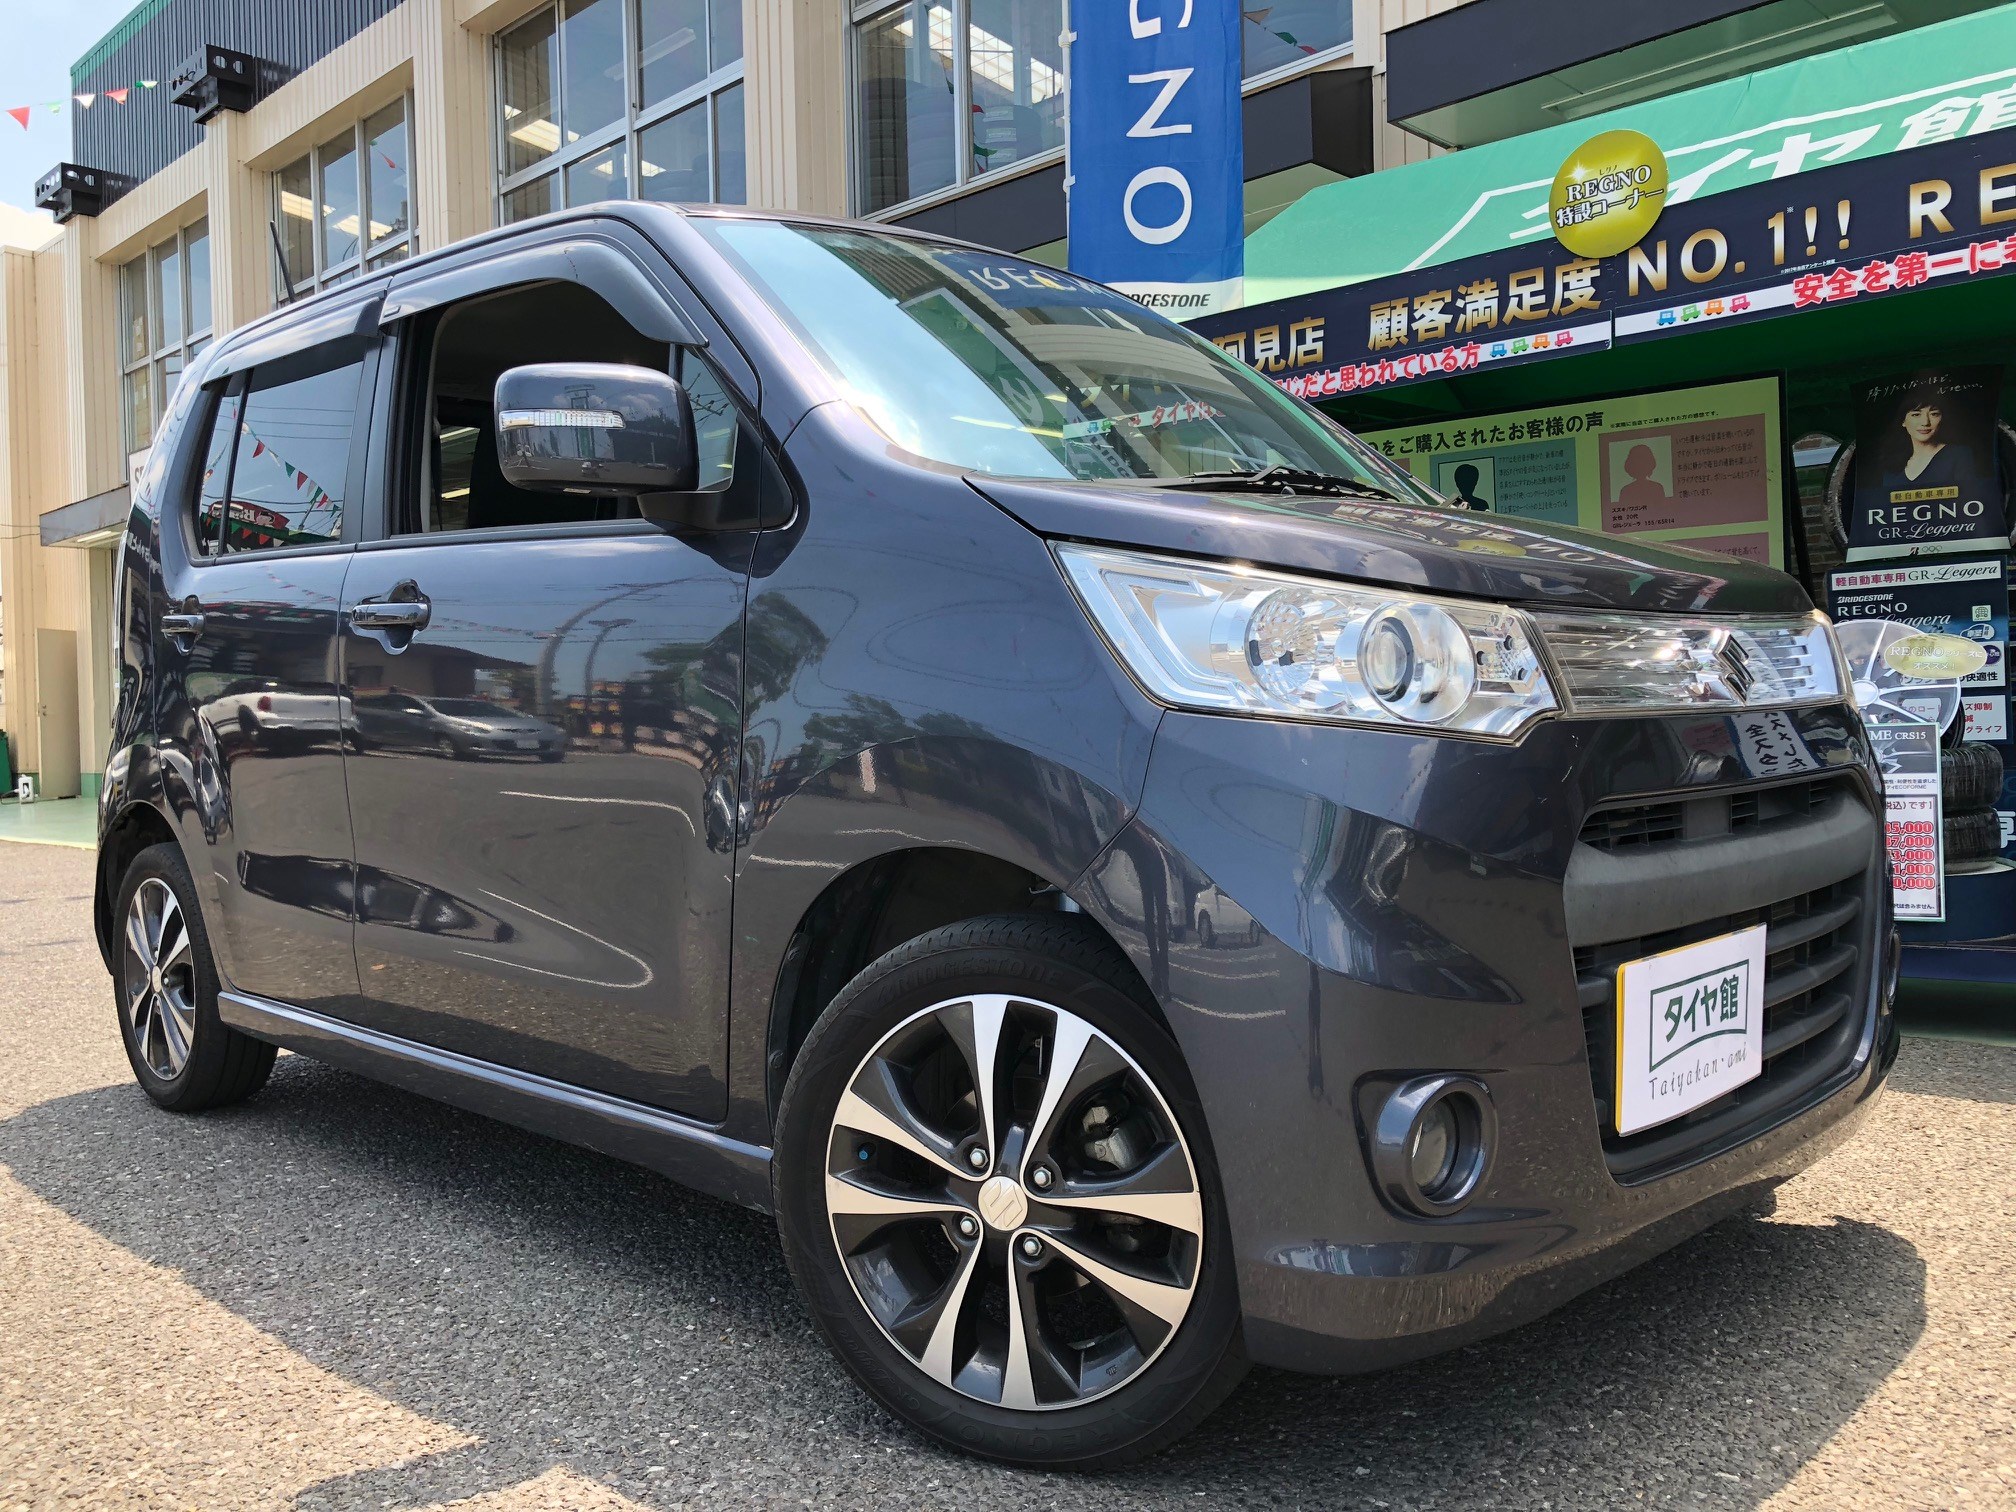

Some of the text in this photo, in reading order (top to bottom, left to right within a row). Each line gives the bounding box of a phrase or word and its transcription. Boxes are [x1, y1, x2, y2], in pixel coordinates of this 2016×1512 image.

[1566, 165, 1651, 203] REGNO
[1556, 188, 1664, 228] 特設コーナー
[1127, 293, 1211, 307] DGESTONE
[1368, 259, 1601, 351] 顧客満足度
[1868, 501, 1984, 525] REGNO
[1878, 521, 1976, 540] GR-Leggera
[1835, 565, 1998, 587] 軽自動車専用 GR-Leggera
[1837, 593, 1894, 604] BRIDGESTONE
[1838, 602, 1908, 617] REGNO
[1895, 732, 1926, 740] CRS15
[1664, 973, 1740, 1043] タイヤ館
